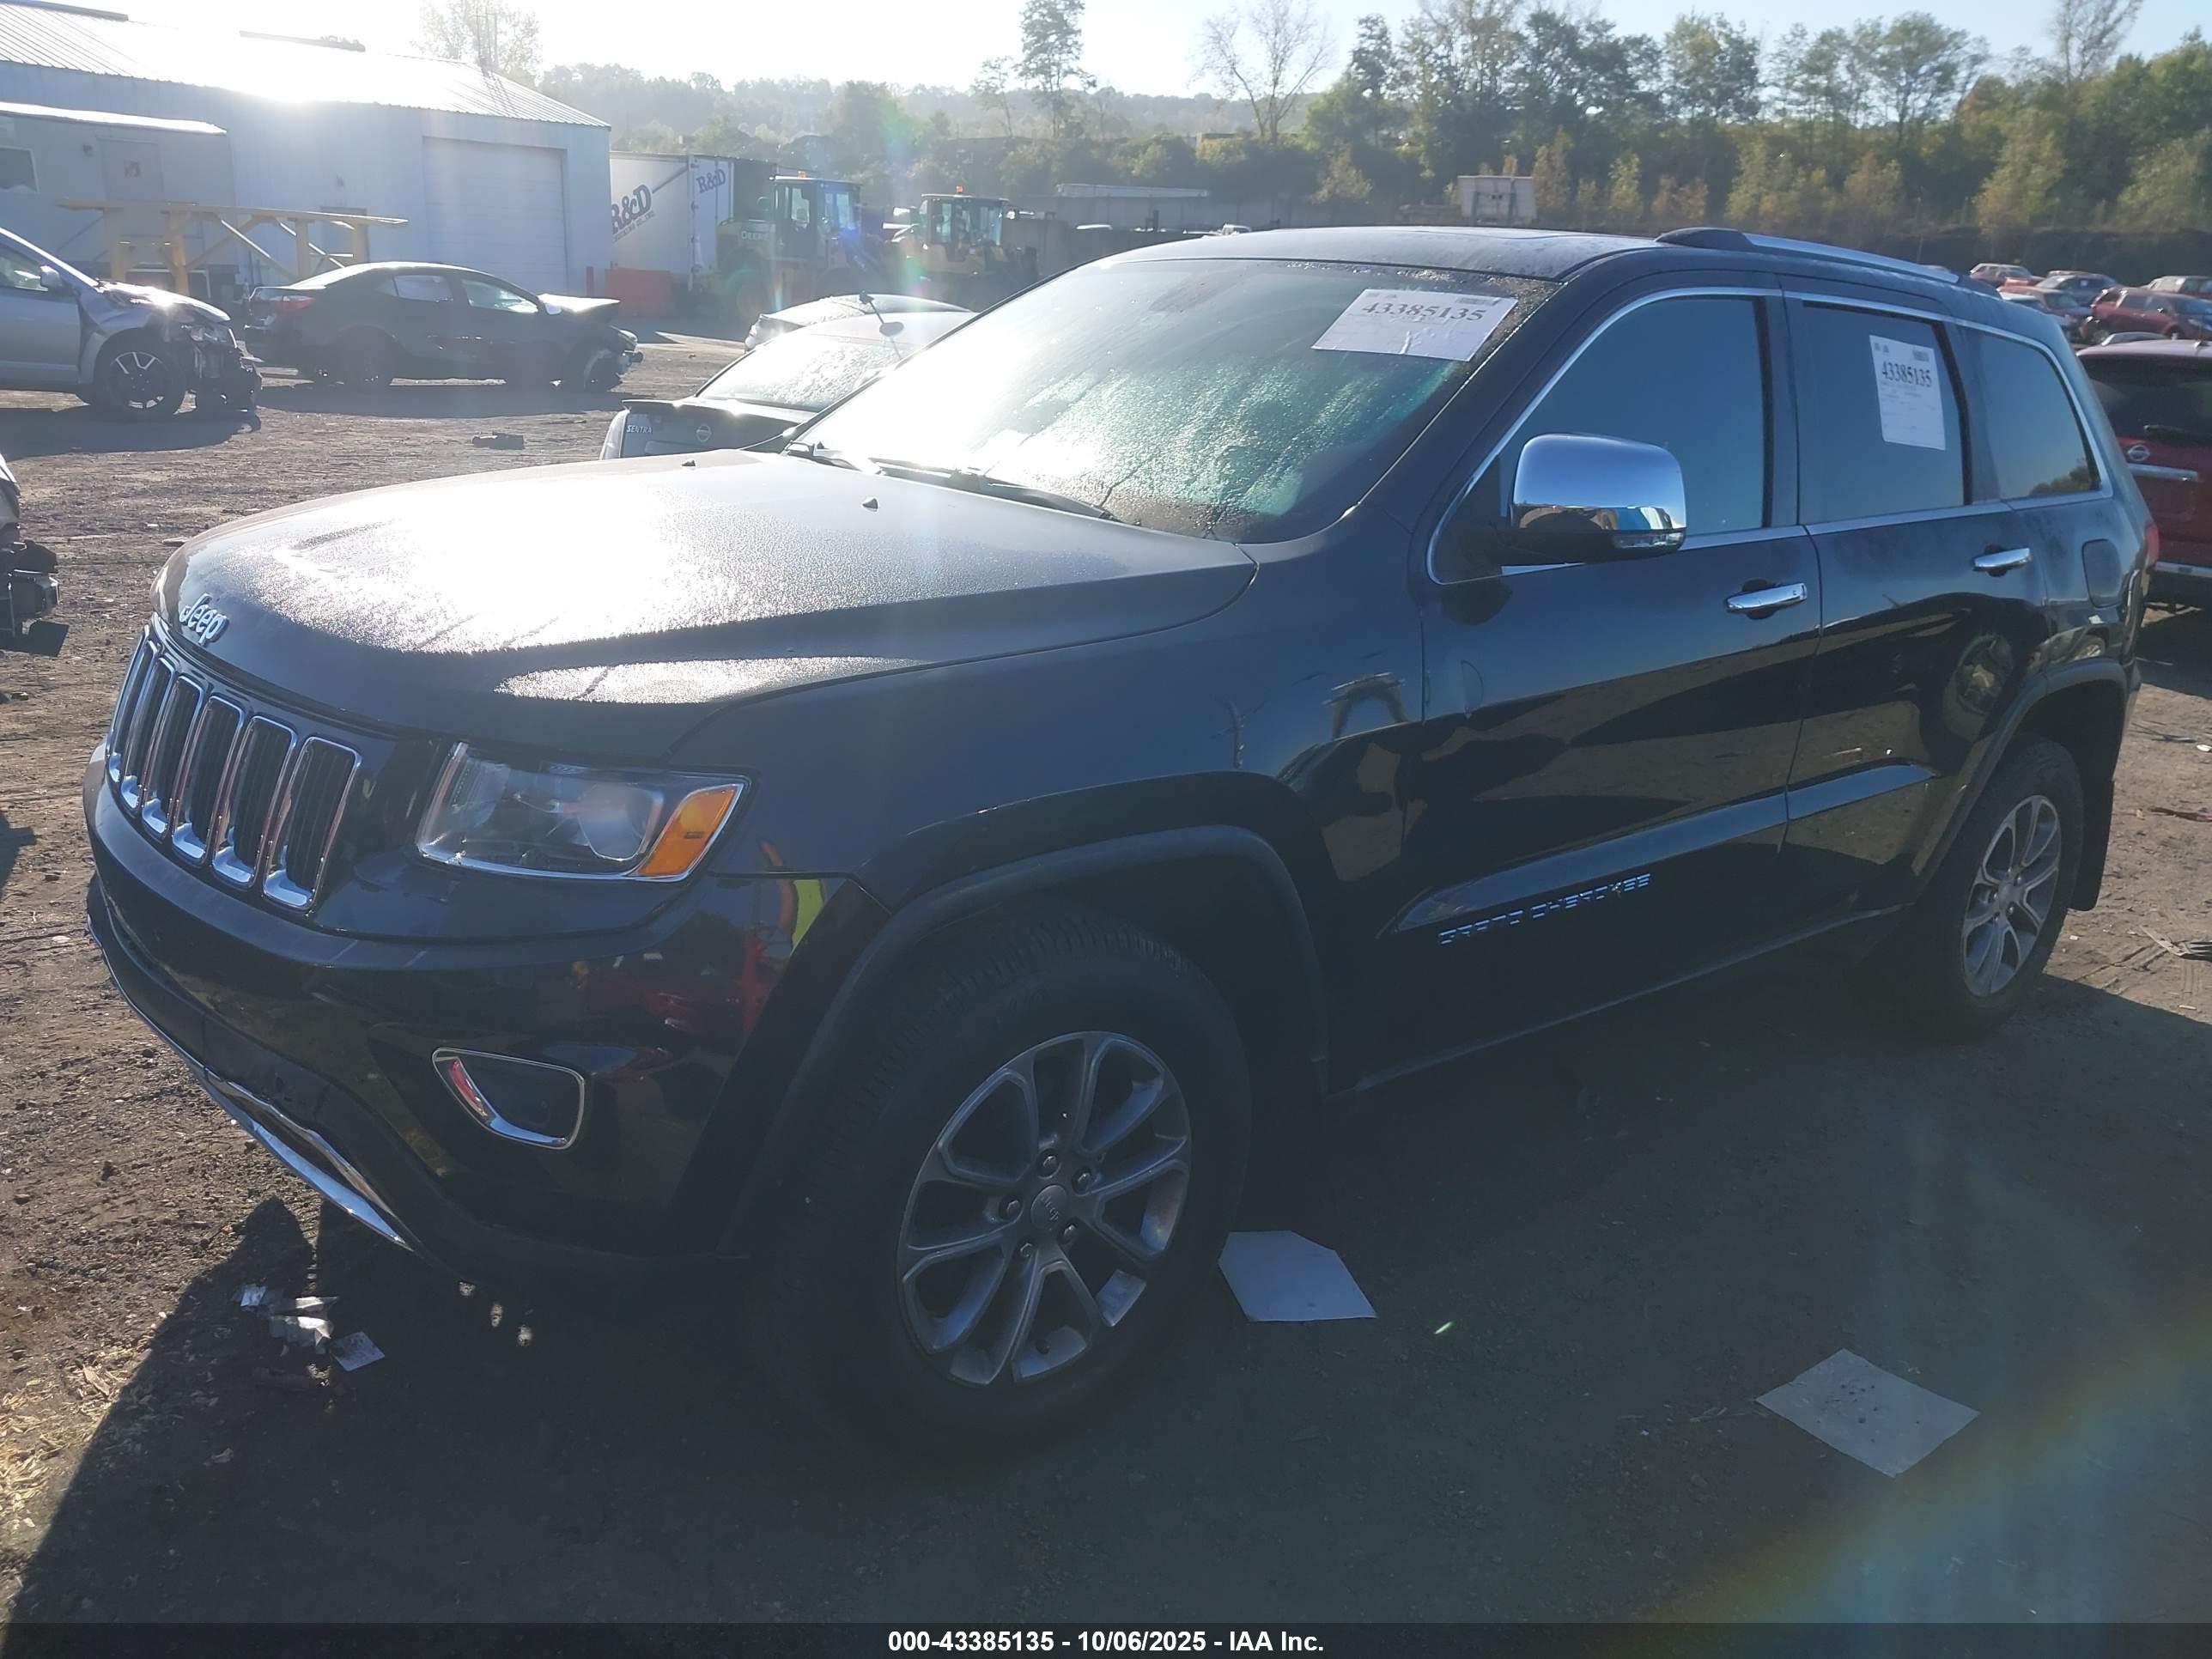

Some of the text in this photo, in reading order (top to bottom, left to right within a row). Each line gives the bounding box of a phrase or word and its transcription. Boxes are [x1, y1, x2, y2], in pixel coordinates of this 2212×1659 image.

[696, 169, 726, 193] R&D
[611, 184, 652, 234] R&D
[1362, 301, 1487, 322] 43385135
[1881, 360, 1932, 387] 43385135
[626, 424, 653, 434] SENTRA
[179, 592, 228, 646] Jeep
